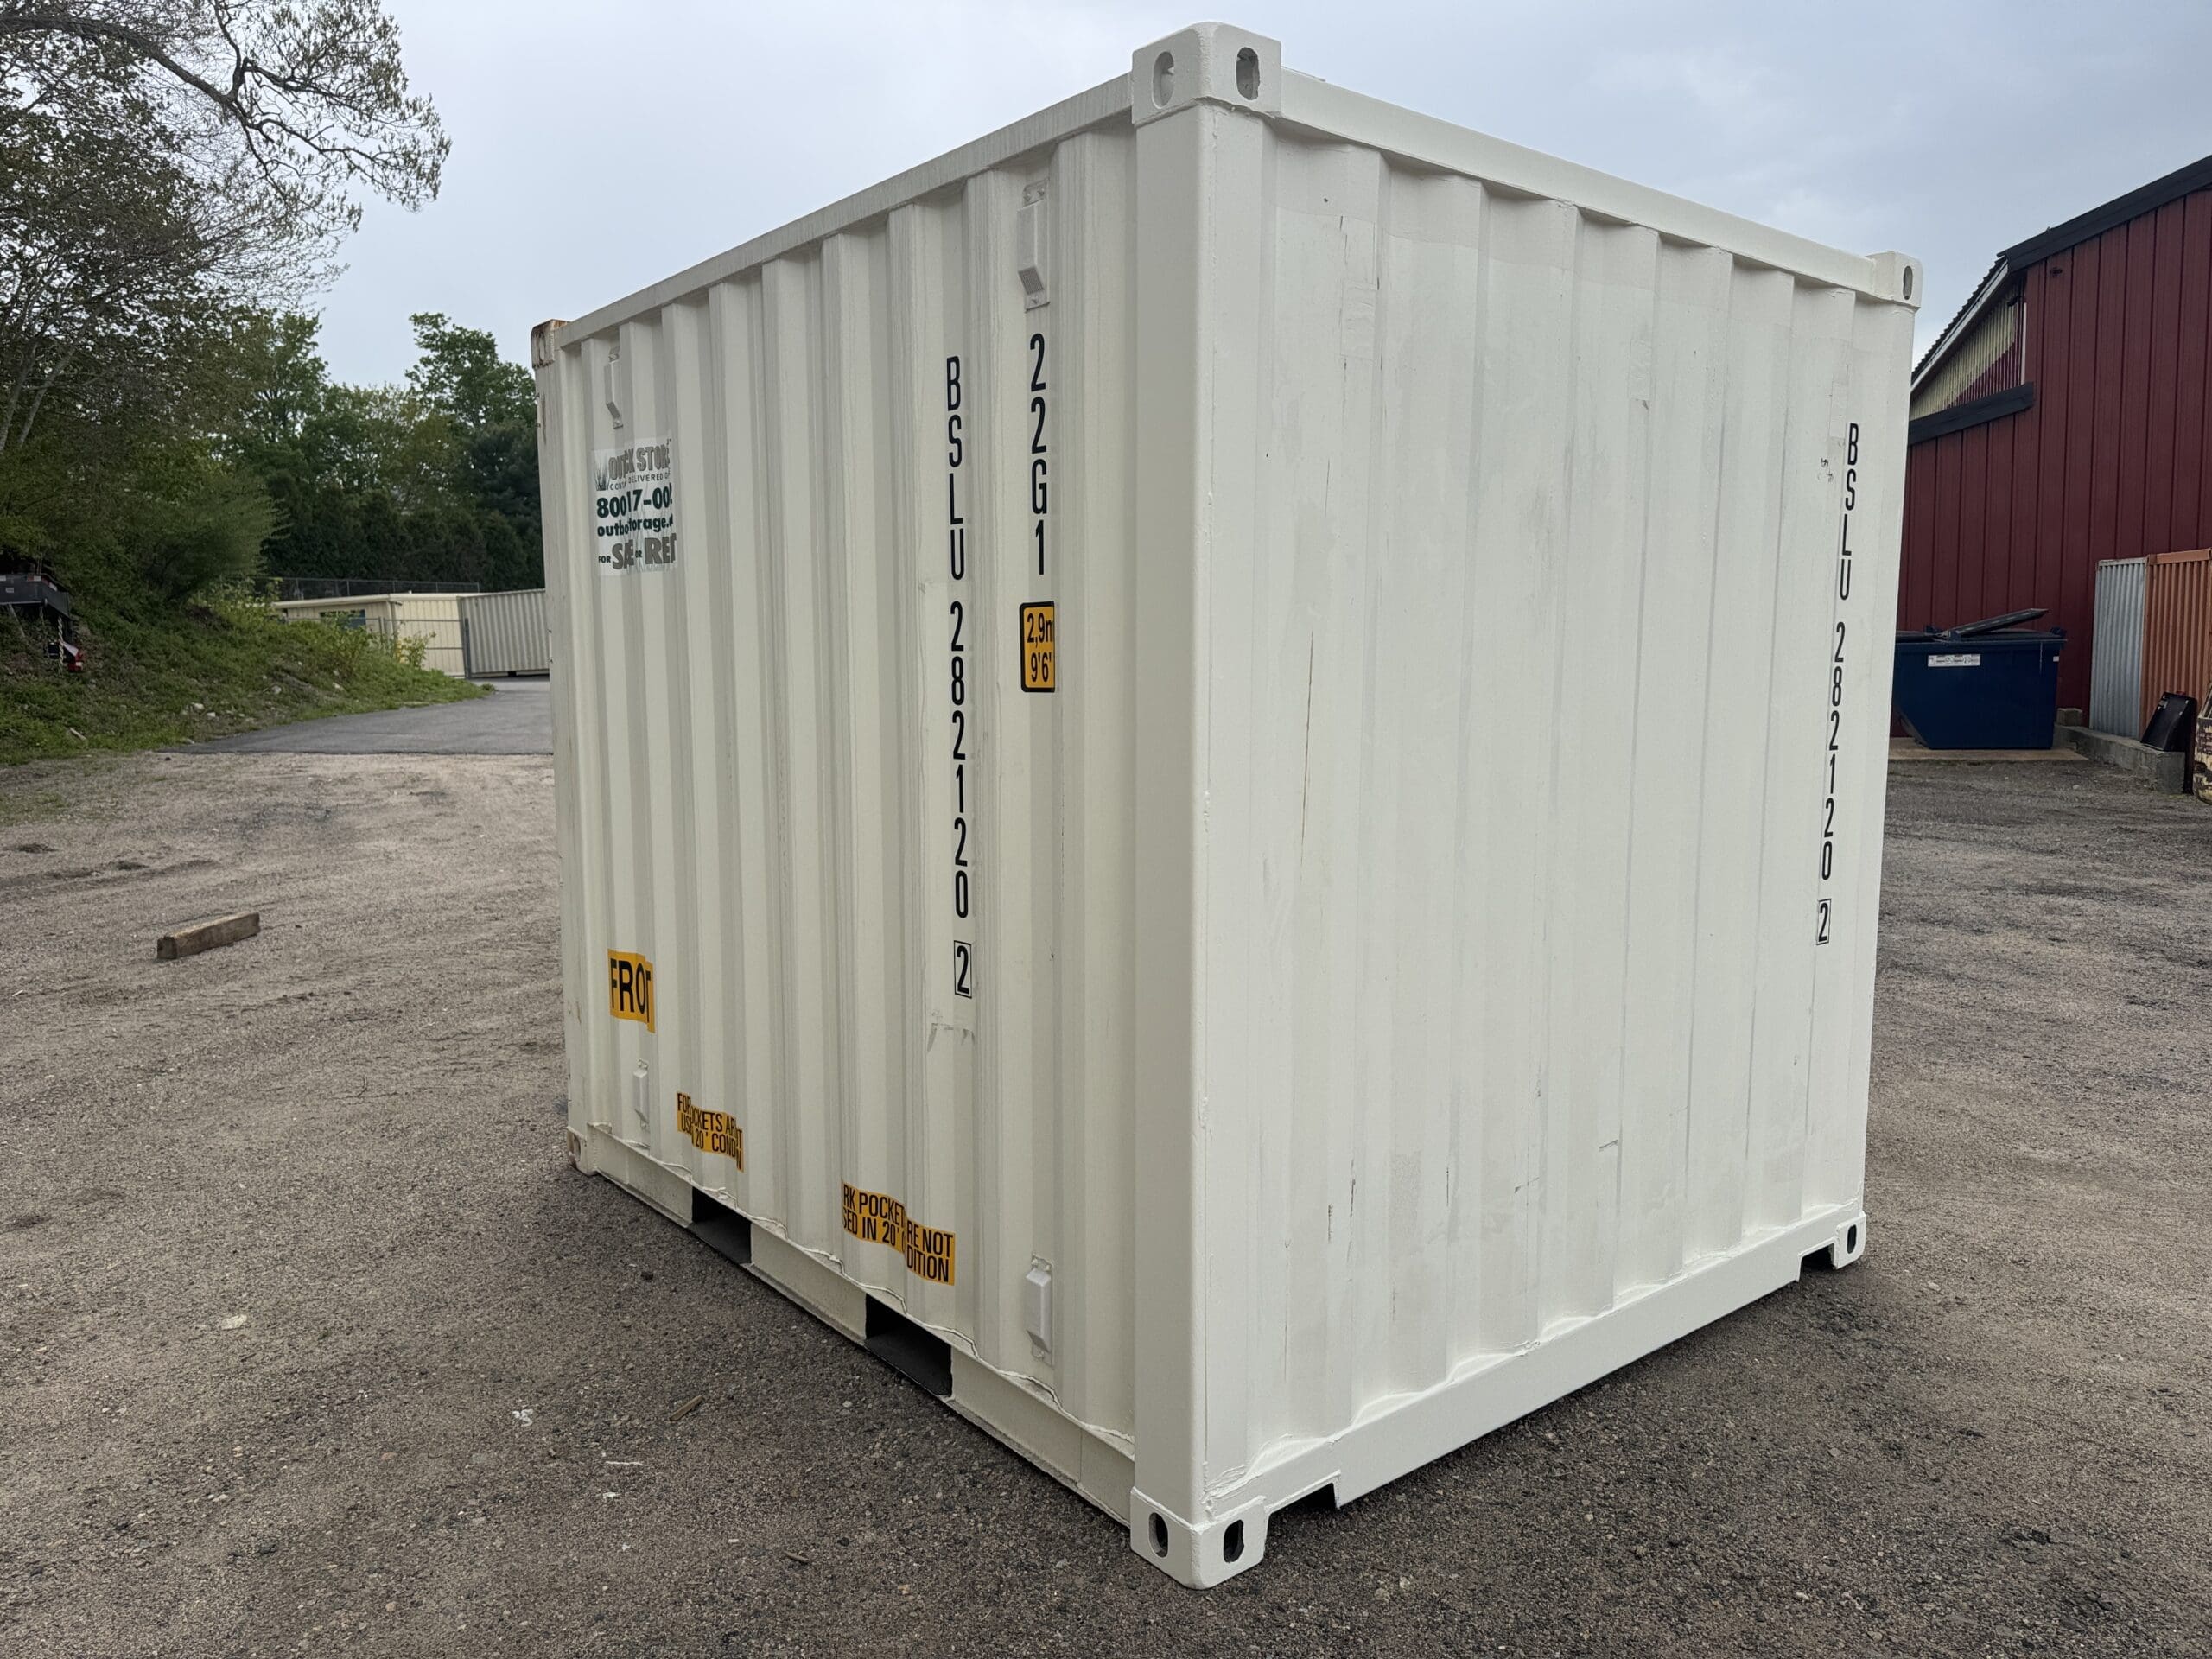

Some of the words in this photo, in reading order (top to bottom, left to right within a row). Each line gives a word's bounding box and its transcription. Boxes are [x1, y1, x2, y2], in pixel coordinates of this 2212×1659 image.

[946, 355, 965, 581] BSLU
[1030, 333, 1047, 575] 22G1
[1840, 423, 1859, 601] BSLU
[950, 601, 969, 918] 282120
[1821, 621, 1846, 880] 282120
[956, 944, 970, 995] 2
[1818, 902, 1828, 942] 2
[843, 1183, 856, 1212] RK
[859, 1192, 905, 1228] POCKET
[907, 1219, 919, 1249] RE
[923, 1229, 954, 1258] NOT
[862, 1216, 877, 1241] IN
[882, 1221, 899, 1247] 20'
